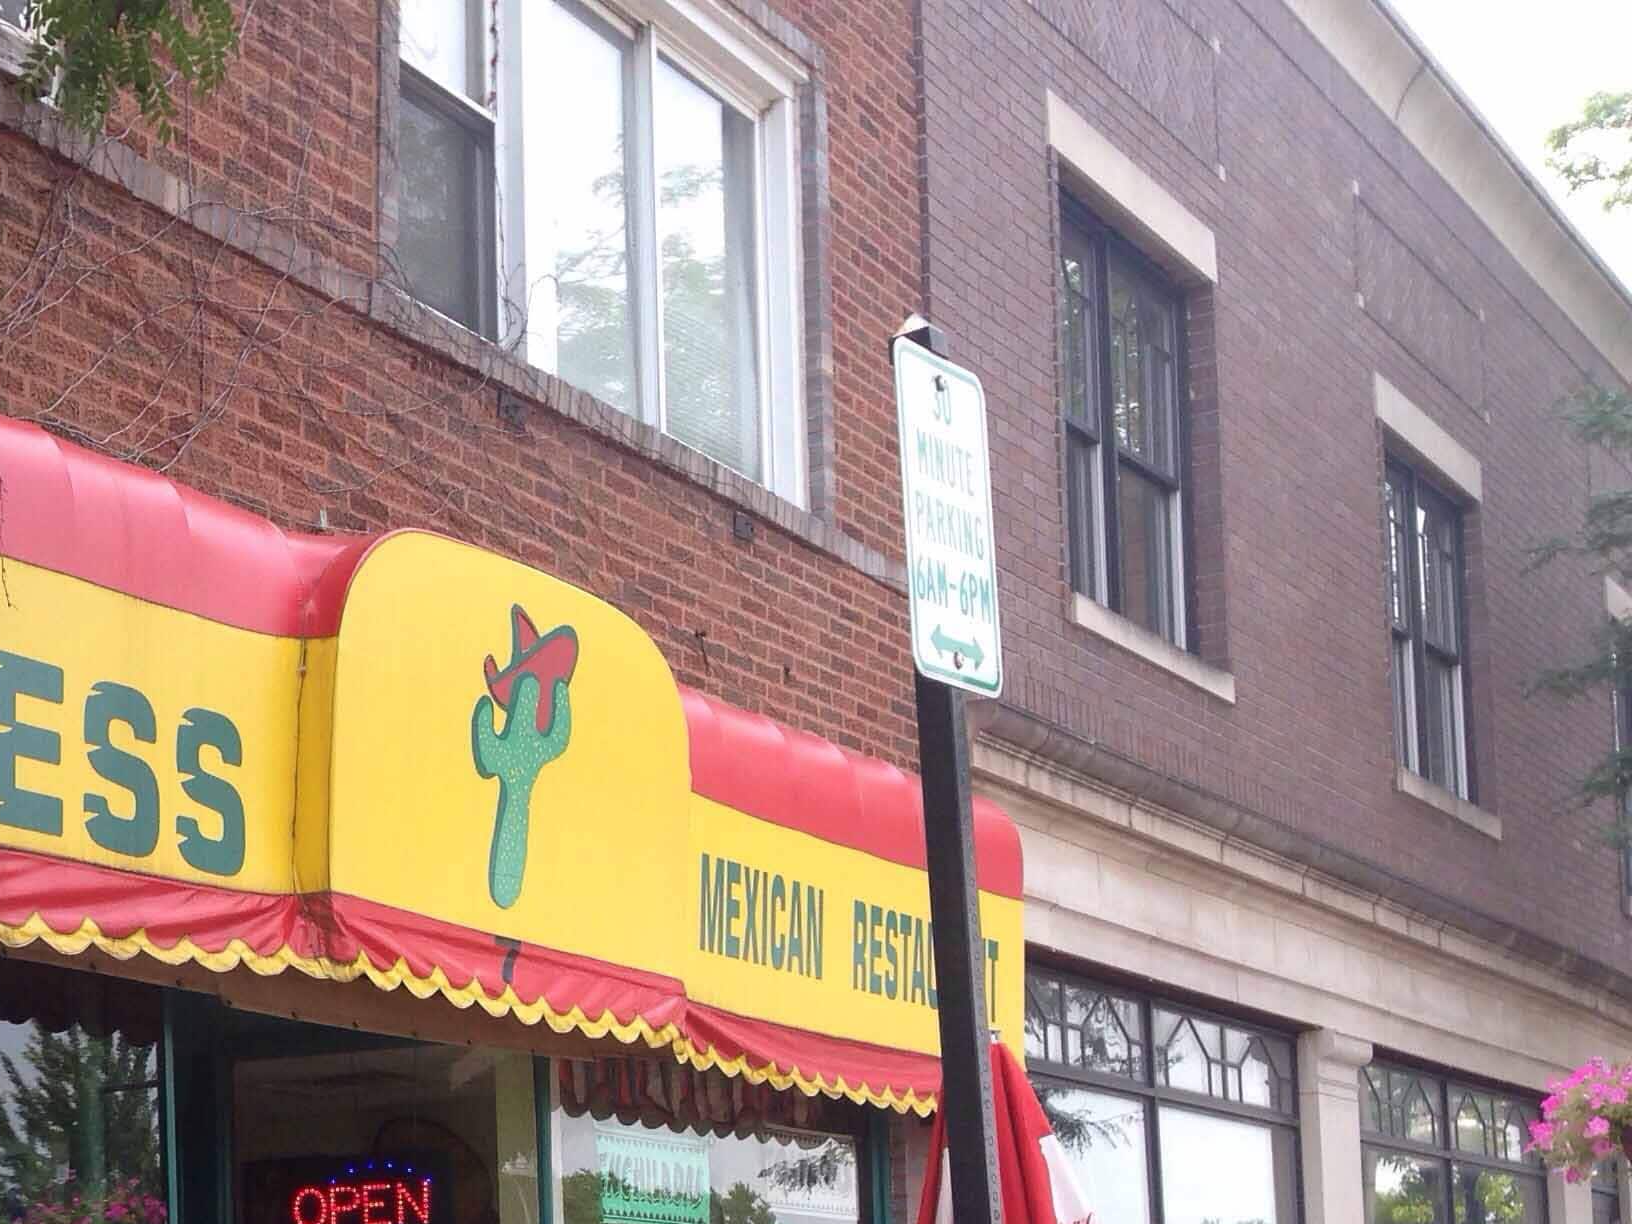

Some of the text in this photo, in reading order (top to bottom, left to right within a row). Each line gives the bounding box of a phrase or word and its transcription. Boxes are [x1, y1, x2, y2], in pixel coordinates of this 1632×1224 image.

[917, 428, 975, 497] MINUTE
[915, 491, 985, 561] PARKING
[917, 555, 992, 624] 6AM-6PM
[700, 853, 824, 980] MEXICAN
